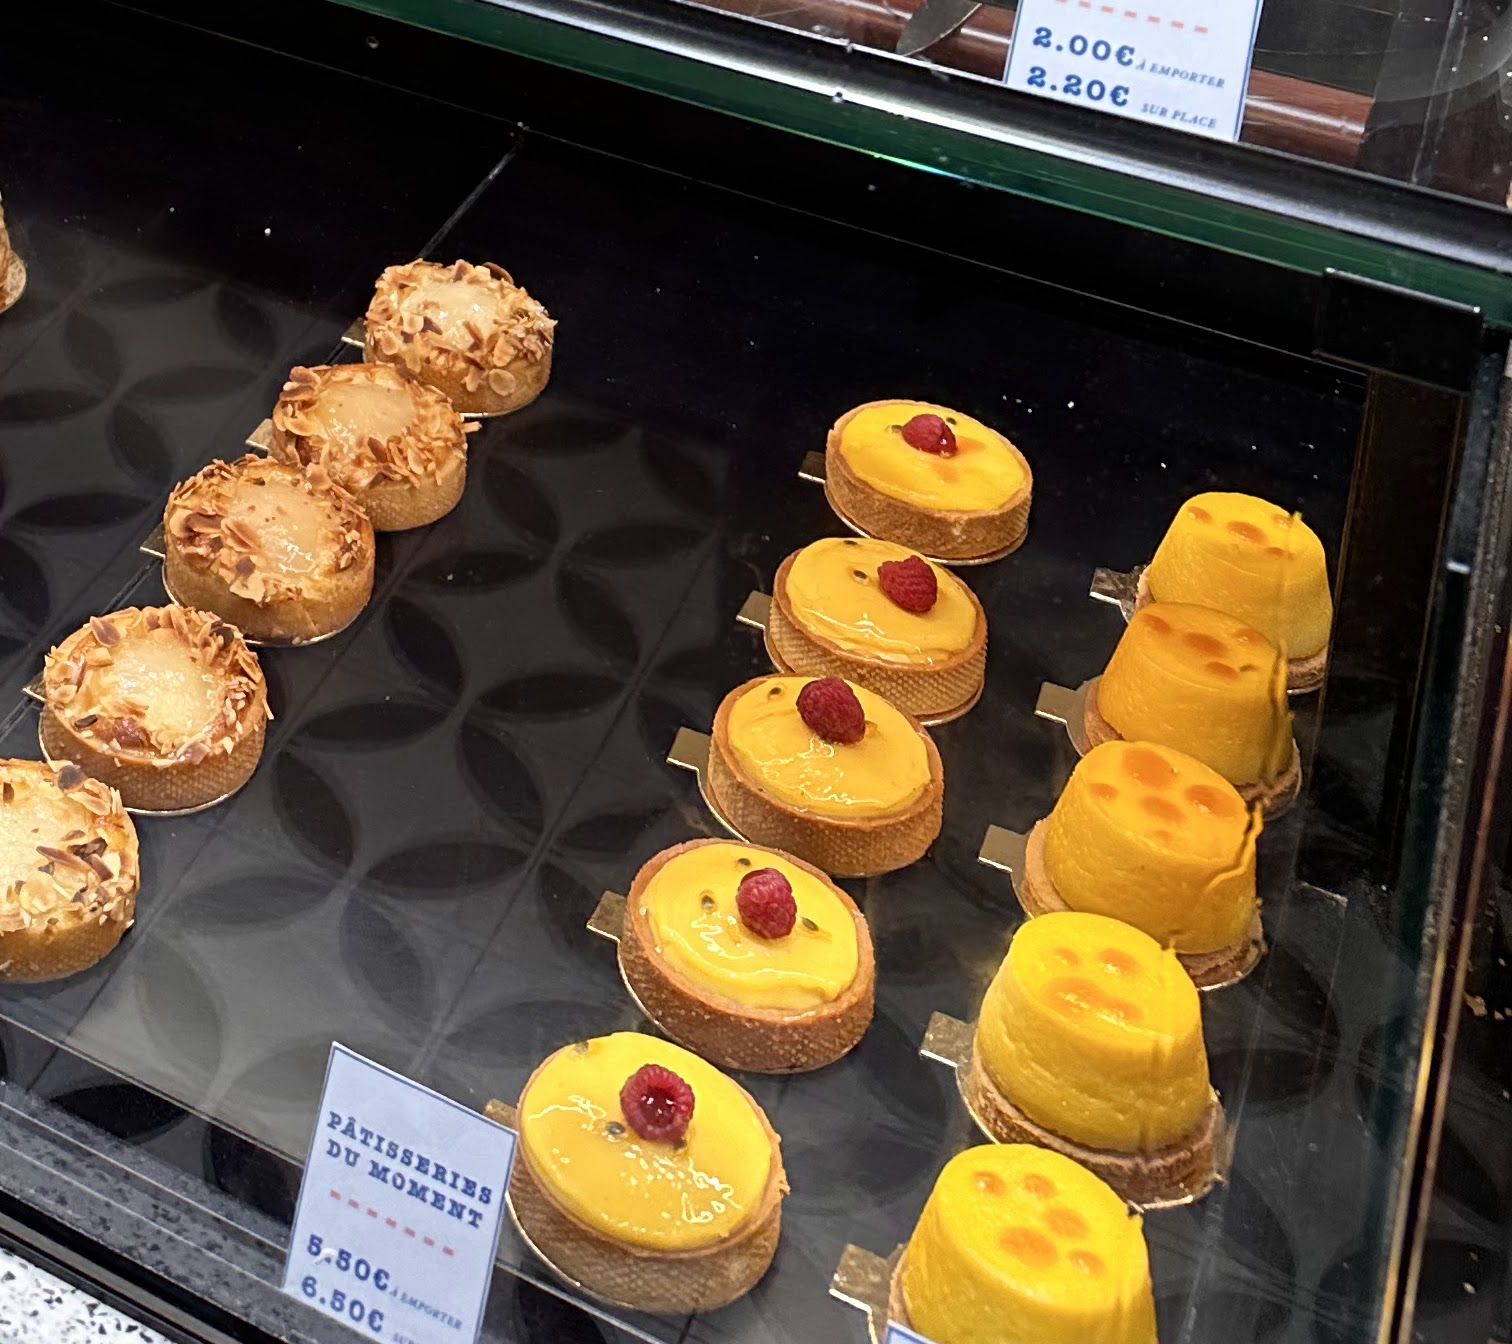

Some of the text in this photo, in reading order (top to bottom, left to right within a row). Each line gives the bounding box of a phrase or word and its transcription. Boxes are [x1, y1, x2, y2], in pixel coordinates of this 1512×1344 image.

[1032, 26, 1136, 67] 2.00€
[1149, 62, 1226, 89] EMPORTER
[1027, 66, 1217, 129] 2.20€ SUR PLACE
[327, 1111, 493, 1205] PÂTISSERIES
[327, 1139, 483, 1229] DU MOMENT
[307, 1234, 390, 1292] 5.50€
[301, 1275, 385, 1333] 6.50€
